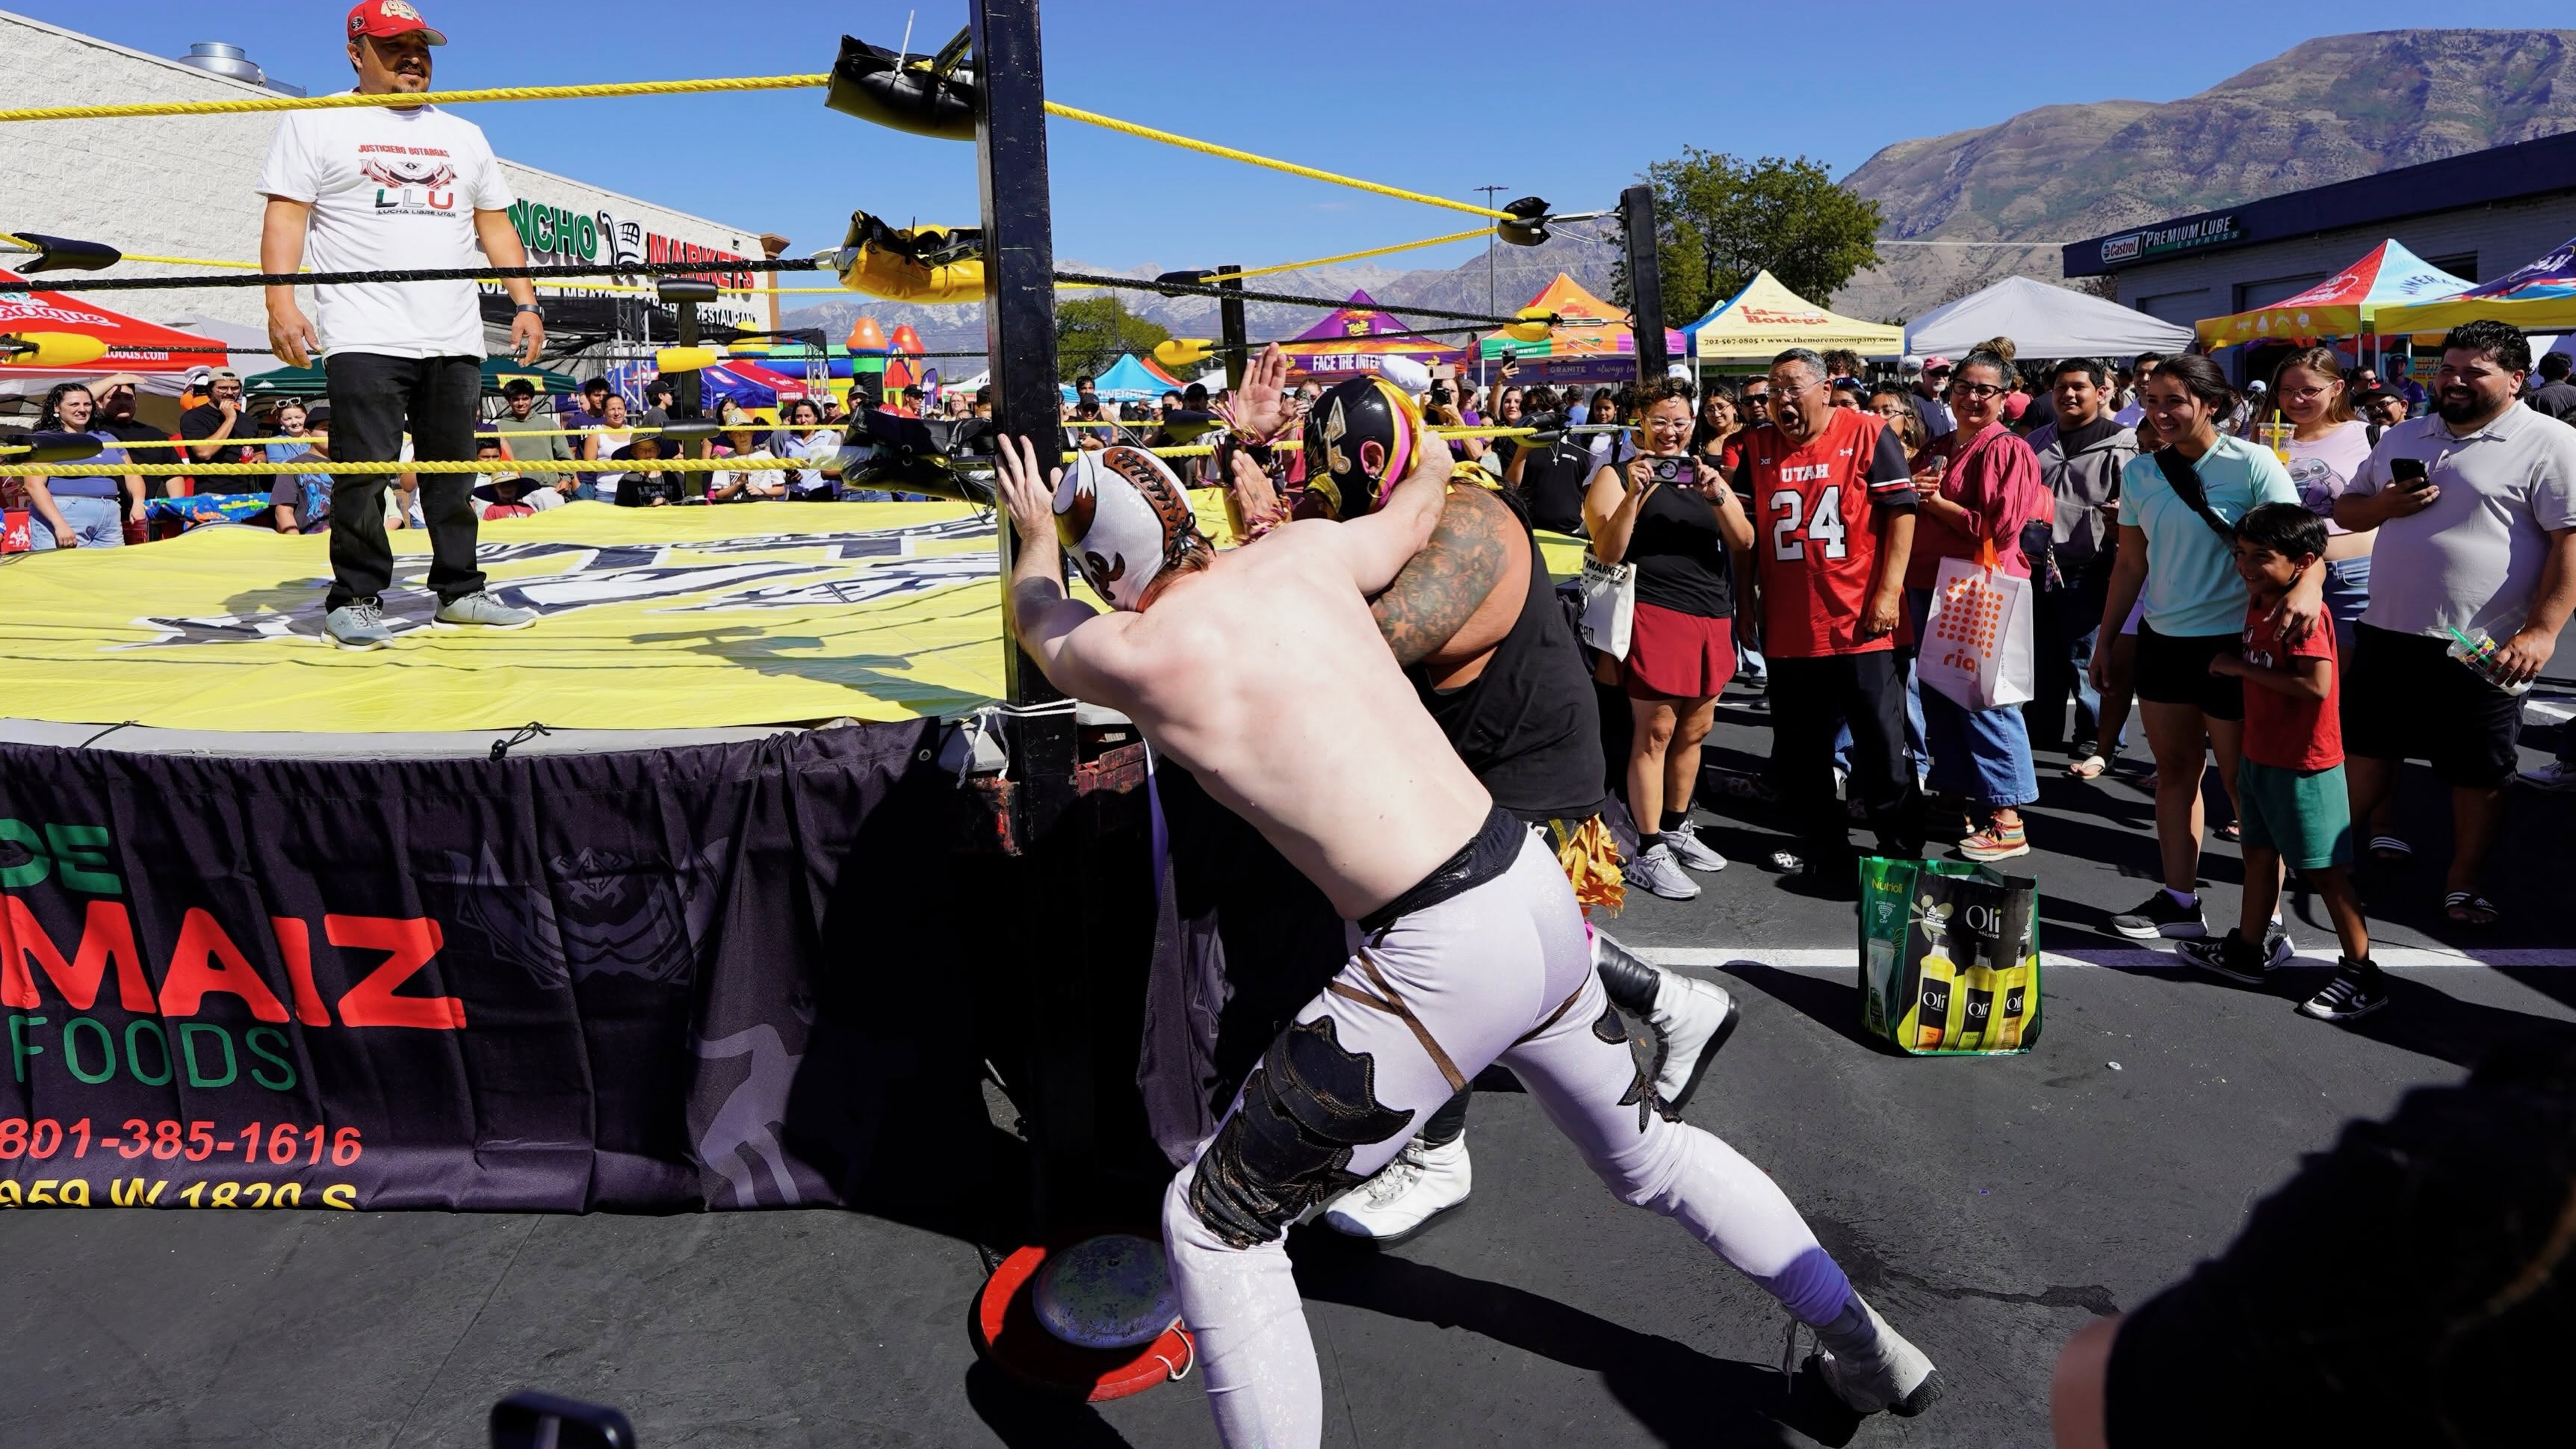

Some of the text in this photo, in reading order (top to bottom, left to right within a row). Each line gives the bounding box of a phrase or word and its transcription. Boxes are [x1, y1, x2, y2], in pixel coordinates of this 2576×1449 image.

[359, 145, 450, 158] JUSTICIERO BOTARGAS
[375, 189, 453, 210] LLU
[507, 198, 755, 291] NCHO MARKETS
[2111, 216, 2234, 257] Castrol PREMIUM LUBE
[2177, 230, 2240, 249] EXPRESS
[0, 305, 120, 323] acique
[1740, 305, 1768, 316] La
[1744, 314, 1830, 326] Bodega
[1767, 336, 1897, 346] www.themorenocompany.com
[1313, 356, 1337, 371] FACE
[1337, 355, 1354, 370] THE
[1597, 364, 1623, 377] always
[1096, 389, 1153, 399] OWERADE
[1781, 463, 1830, 483] UTAH
[1770, 485, 1847, 560] 24
[1586, 559, 1627, 580] MARKETS
[0, 819, 123, 895] DE
[1871, 876, 1903, 893] Nutrioli
[1966, 905, 2002, 934] Oli
[0, 893, 467, 1030] MAIZ
[1922, 991, 1947, 1009] Oli
[1967, 1002, 1990, 1017] Oli
[2006, 995, 2023, 1010] Oli
[8, 1014, 297, 1091] FOODS
[0, 1117, 363, 1167] 801-385-1616
[111, 1177, 169, 1208] W
[321, 1184, 357, 1211] S
